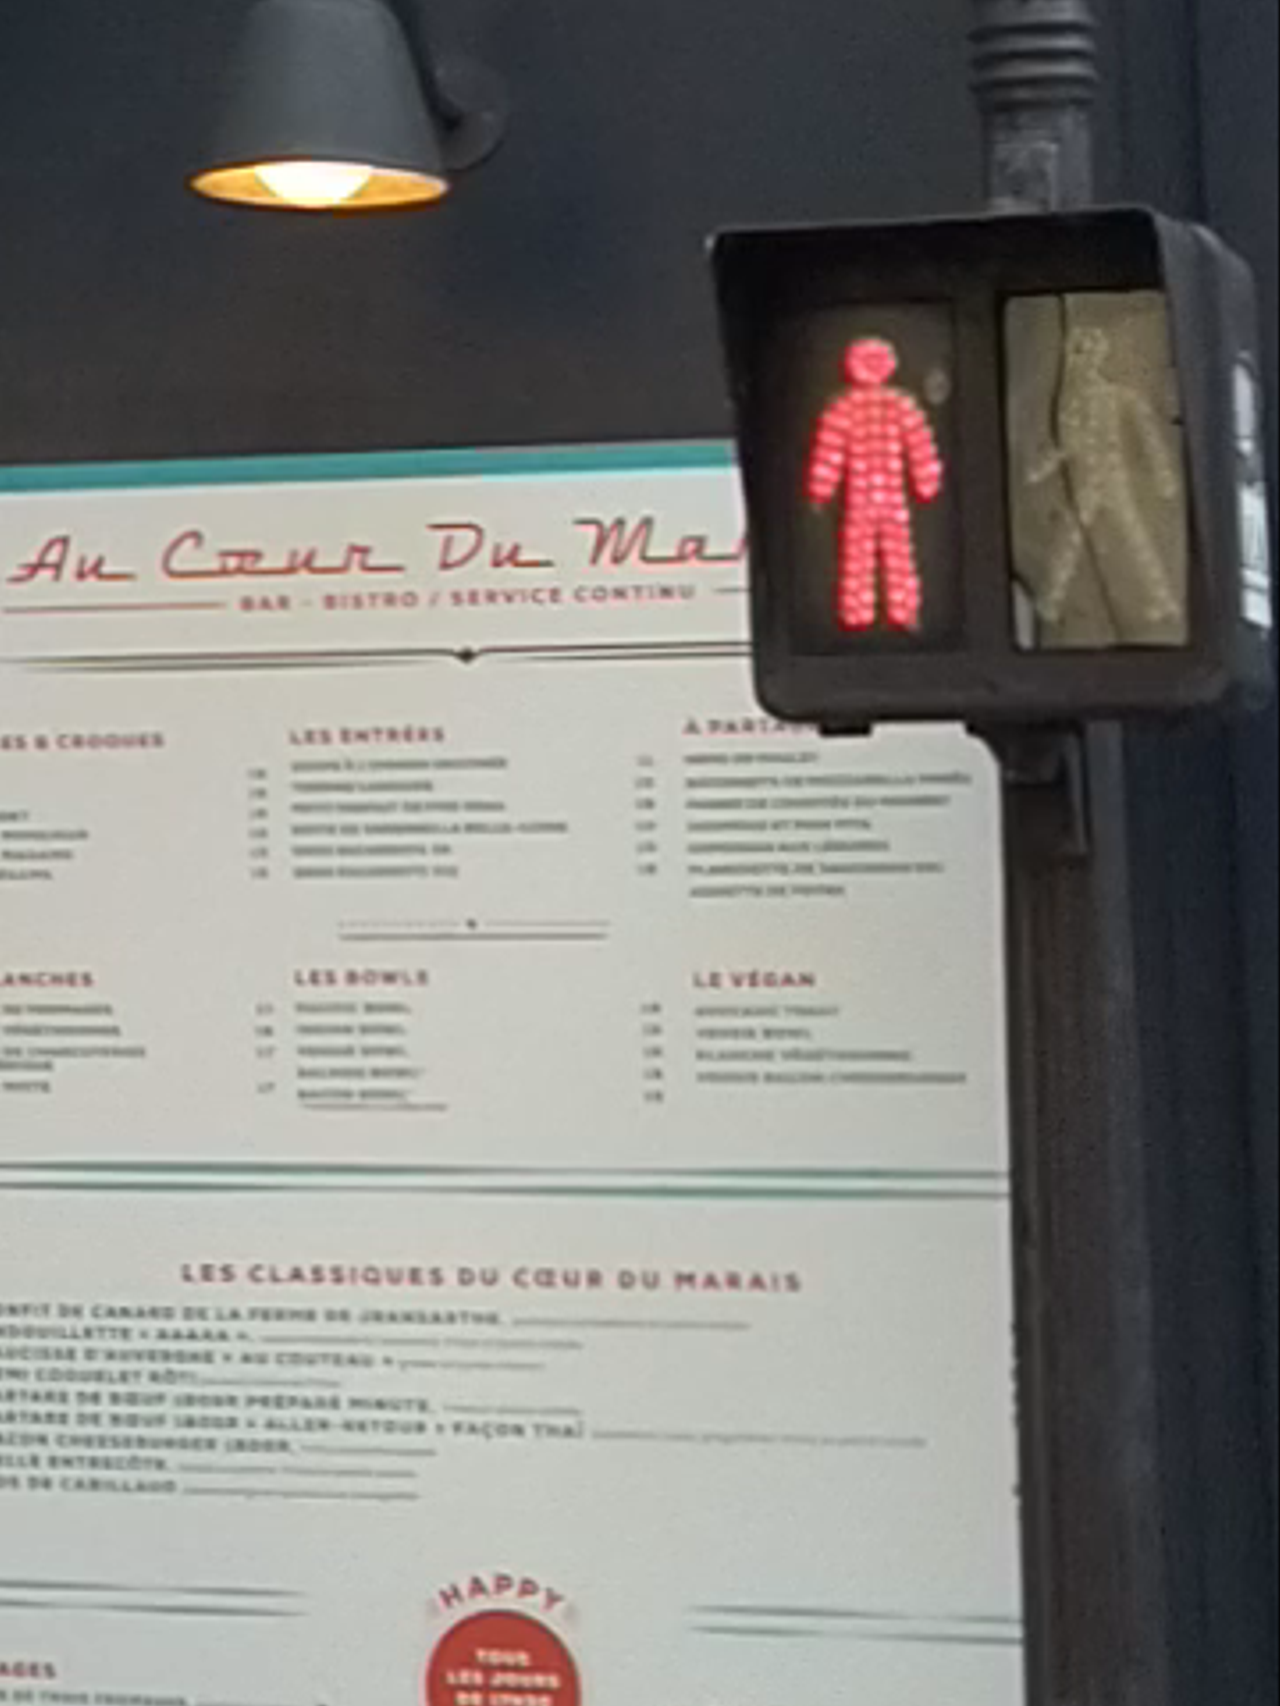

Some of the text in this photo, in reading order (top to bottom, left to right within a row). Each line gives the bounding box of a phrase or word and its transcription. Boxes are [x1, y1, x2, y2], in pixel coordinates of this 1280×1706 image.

[6, 533, 137, 583] Au
[425, 521, 554, 572] Du
[573, 516, 748, 567] Ma
[240, 595, 291, 612] BAR
[323, 590, 419, 610] BISTRO
[450, 587, 562, 607] SERVICE
[574, 584, 696, 604] CONTINU
[55, 732, 166, 750] CROQUES
[290, 728, 333, 746] LES
[294, 968, 429, 987] LES BOWLS
[692, 967, 817, 989] LE VÉGAN
[180, 1262, 805, 1293] LES CLASSIQUES DU CŒUR DU MARAIS
[91, 1303, 176, 1322] CANARD
[437, 1572, 566, 1615] HAPPY
